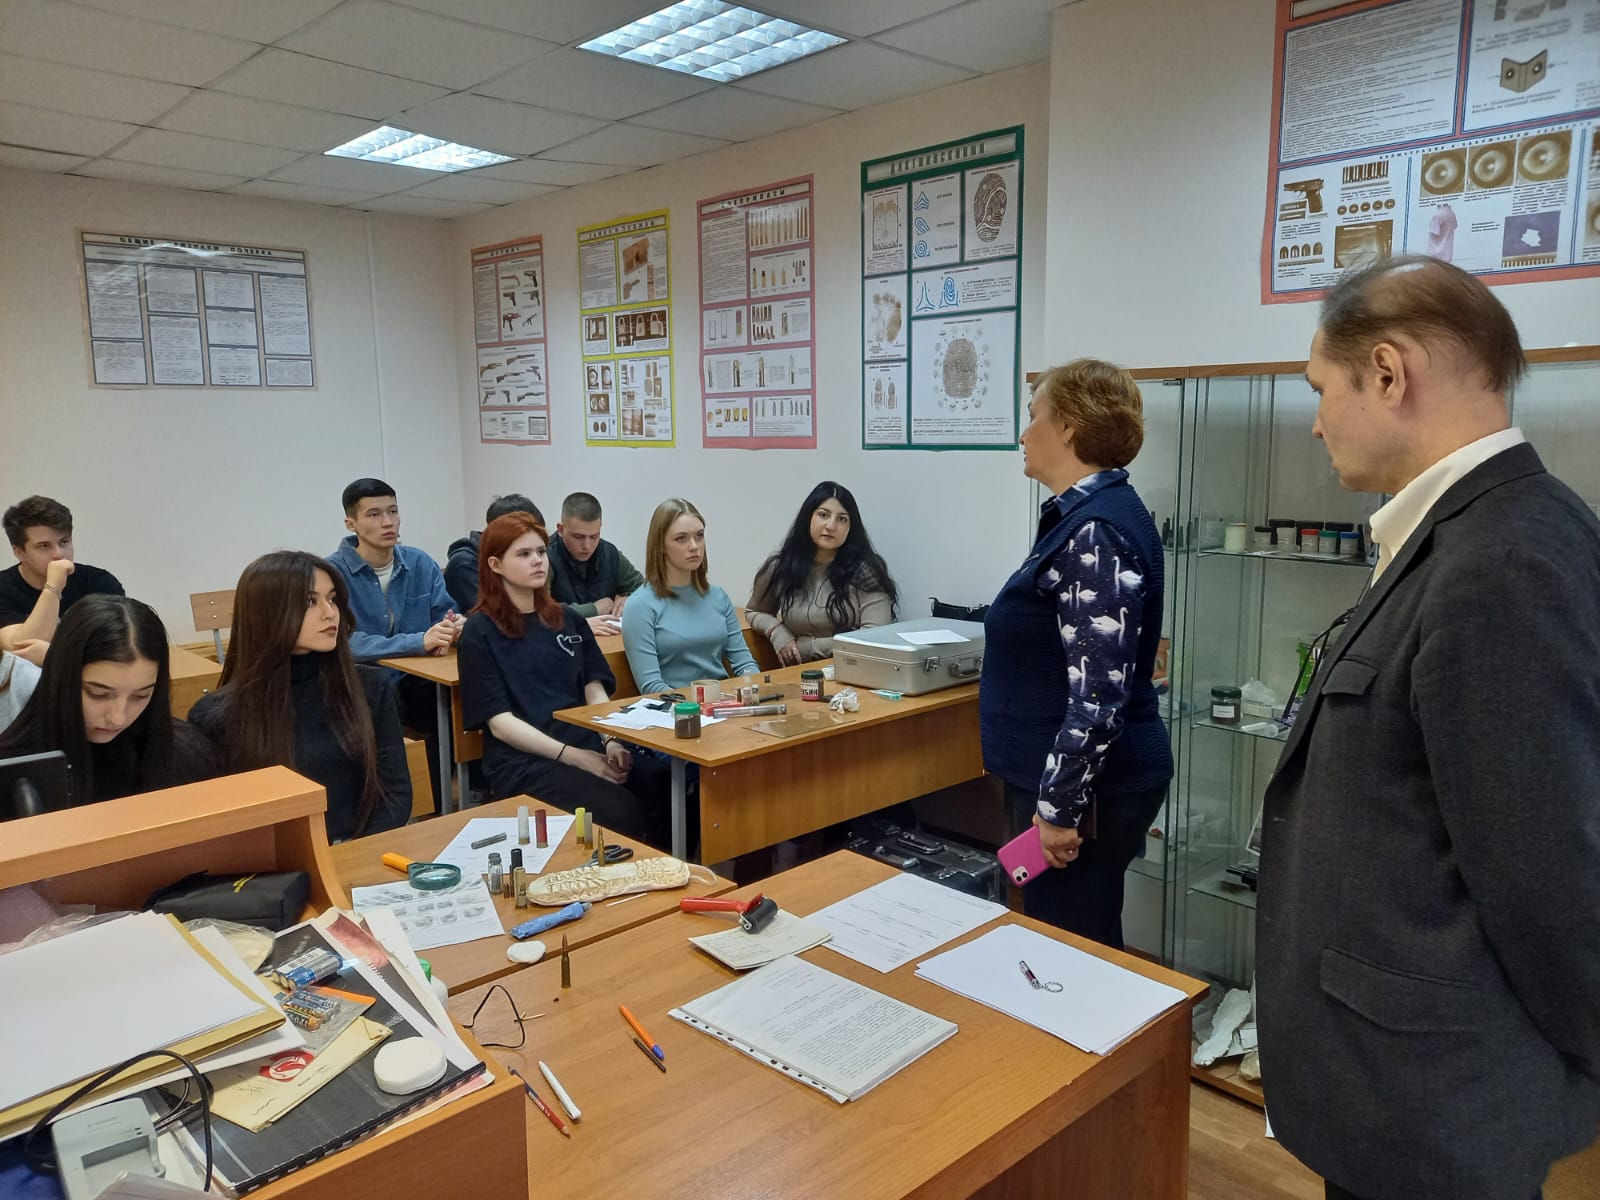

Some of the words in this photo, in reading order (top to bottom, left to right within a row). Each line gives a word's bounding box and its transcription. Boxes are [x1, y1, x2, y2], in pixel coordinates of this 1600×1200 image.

[890, 143, 985, 176] ДАКТИЛОСКОПИЯ
[119, 236, 154, 246] ОБЩИЕ
[230, 246, 273, 256] ПОЧЕРКА
